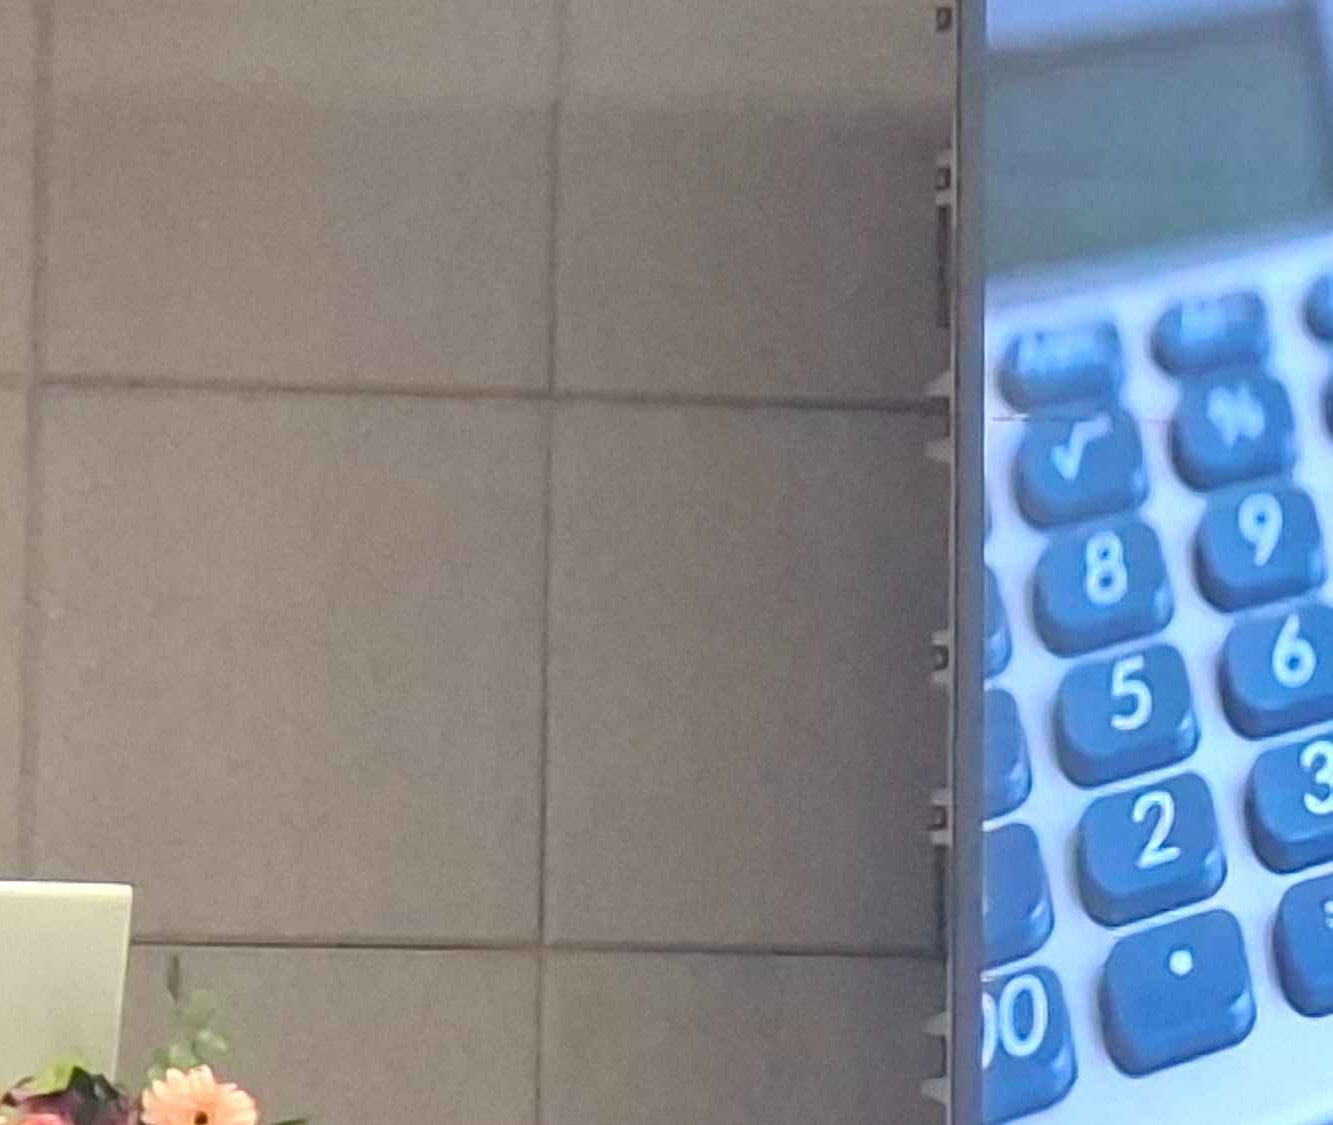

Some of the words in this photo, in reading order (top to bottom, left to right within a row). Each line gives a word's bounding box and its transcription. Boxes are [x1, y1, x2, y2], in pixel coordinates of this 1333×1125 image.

[1237, 492, 1283, 567] 9
[1083, 530, 1129, 607] 8
[1271, 613, 1317, 688] 6
[1110, 655, 1153, 731] 5
[1299, 739, 1333, 815] 3
[1132, 790, 1182, 869] 2
